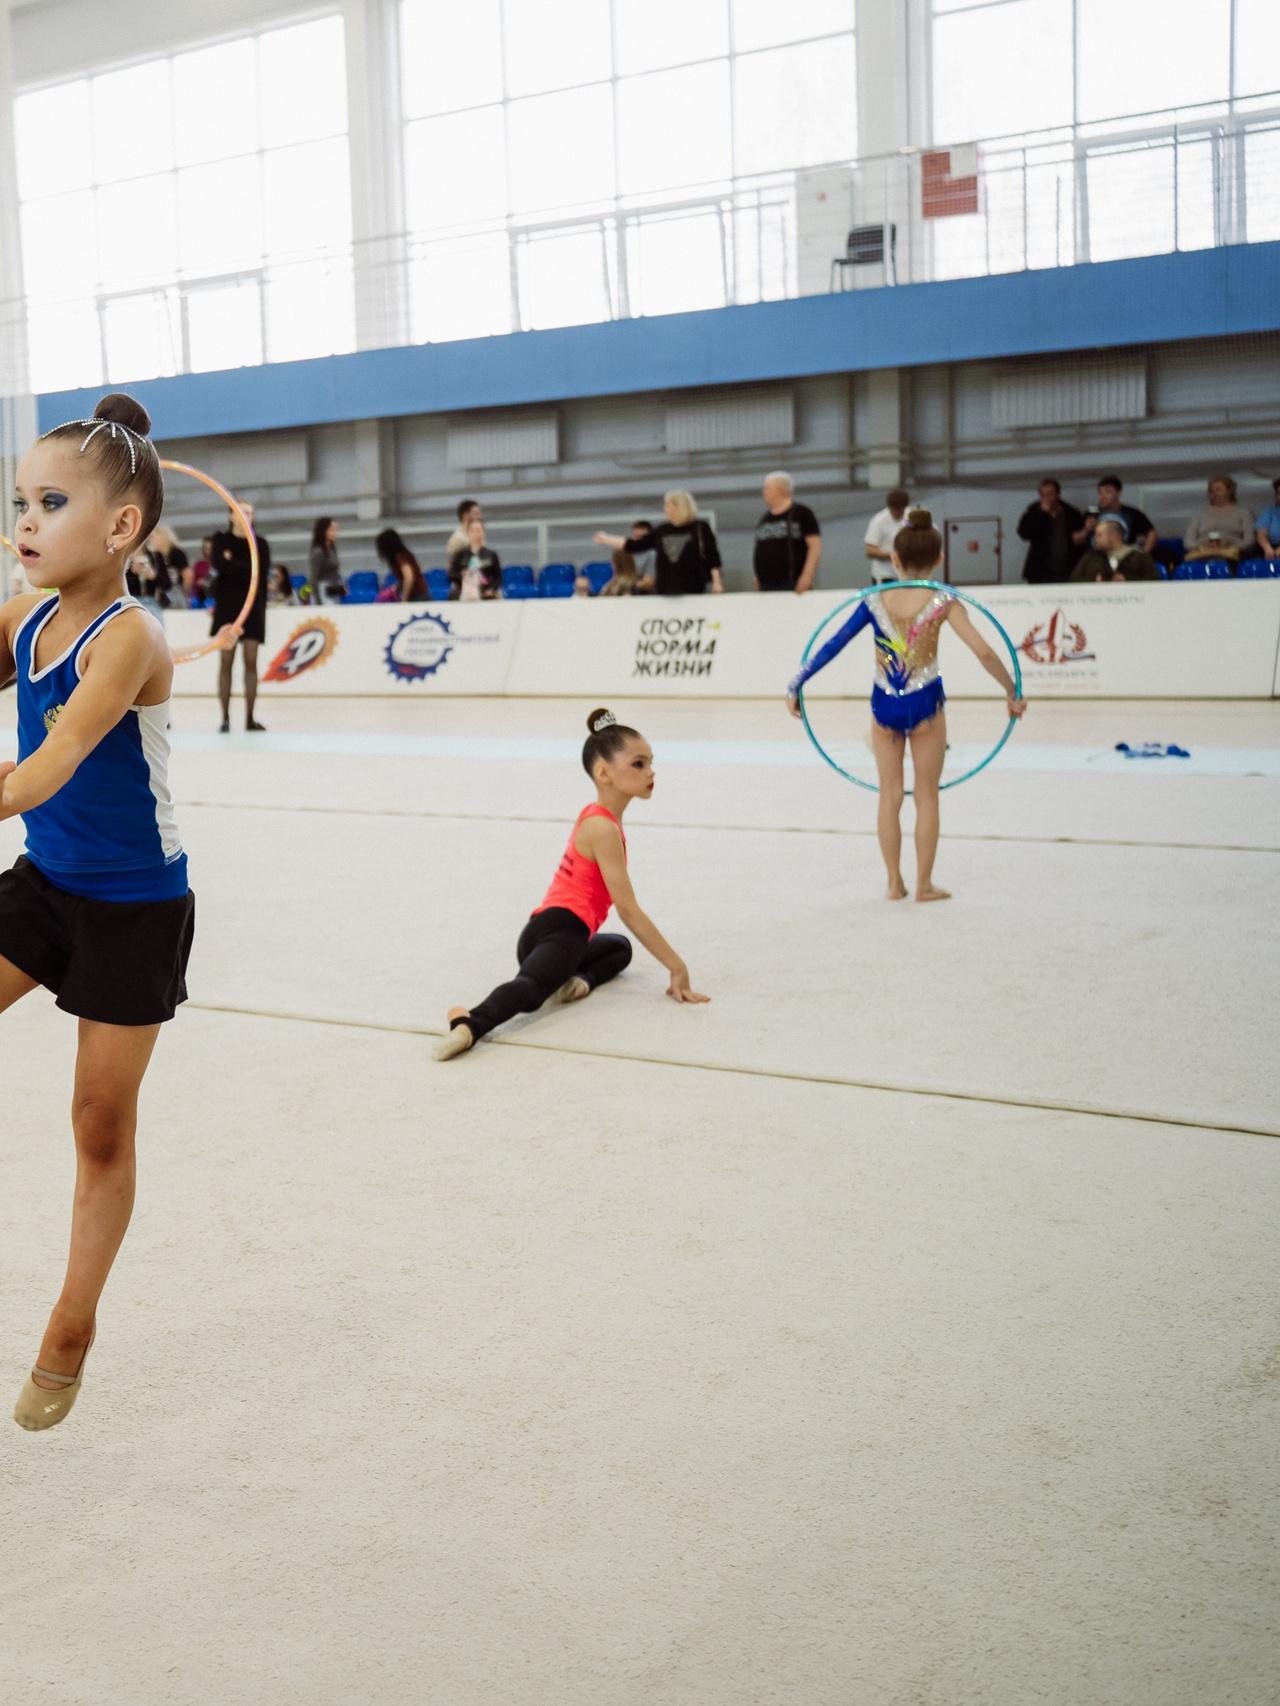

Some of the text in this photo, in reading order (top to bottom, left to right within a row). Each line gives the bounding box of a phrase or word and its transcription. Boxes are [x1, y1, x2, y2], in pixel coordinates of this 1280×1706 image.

[640, 617, 706, 636] СПОРТ
[635, 638, 717, 657] НОРМА
[631, 659, 713, 678] ЖИЗНИ
